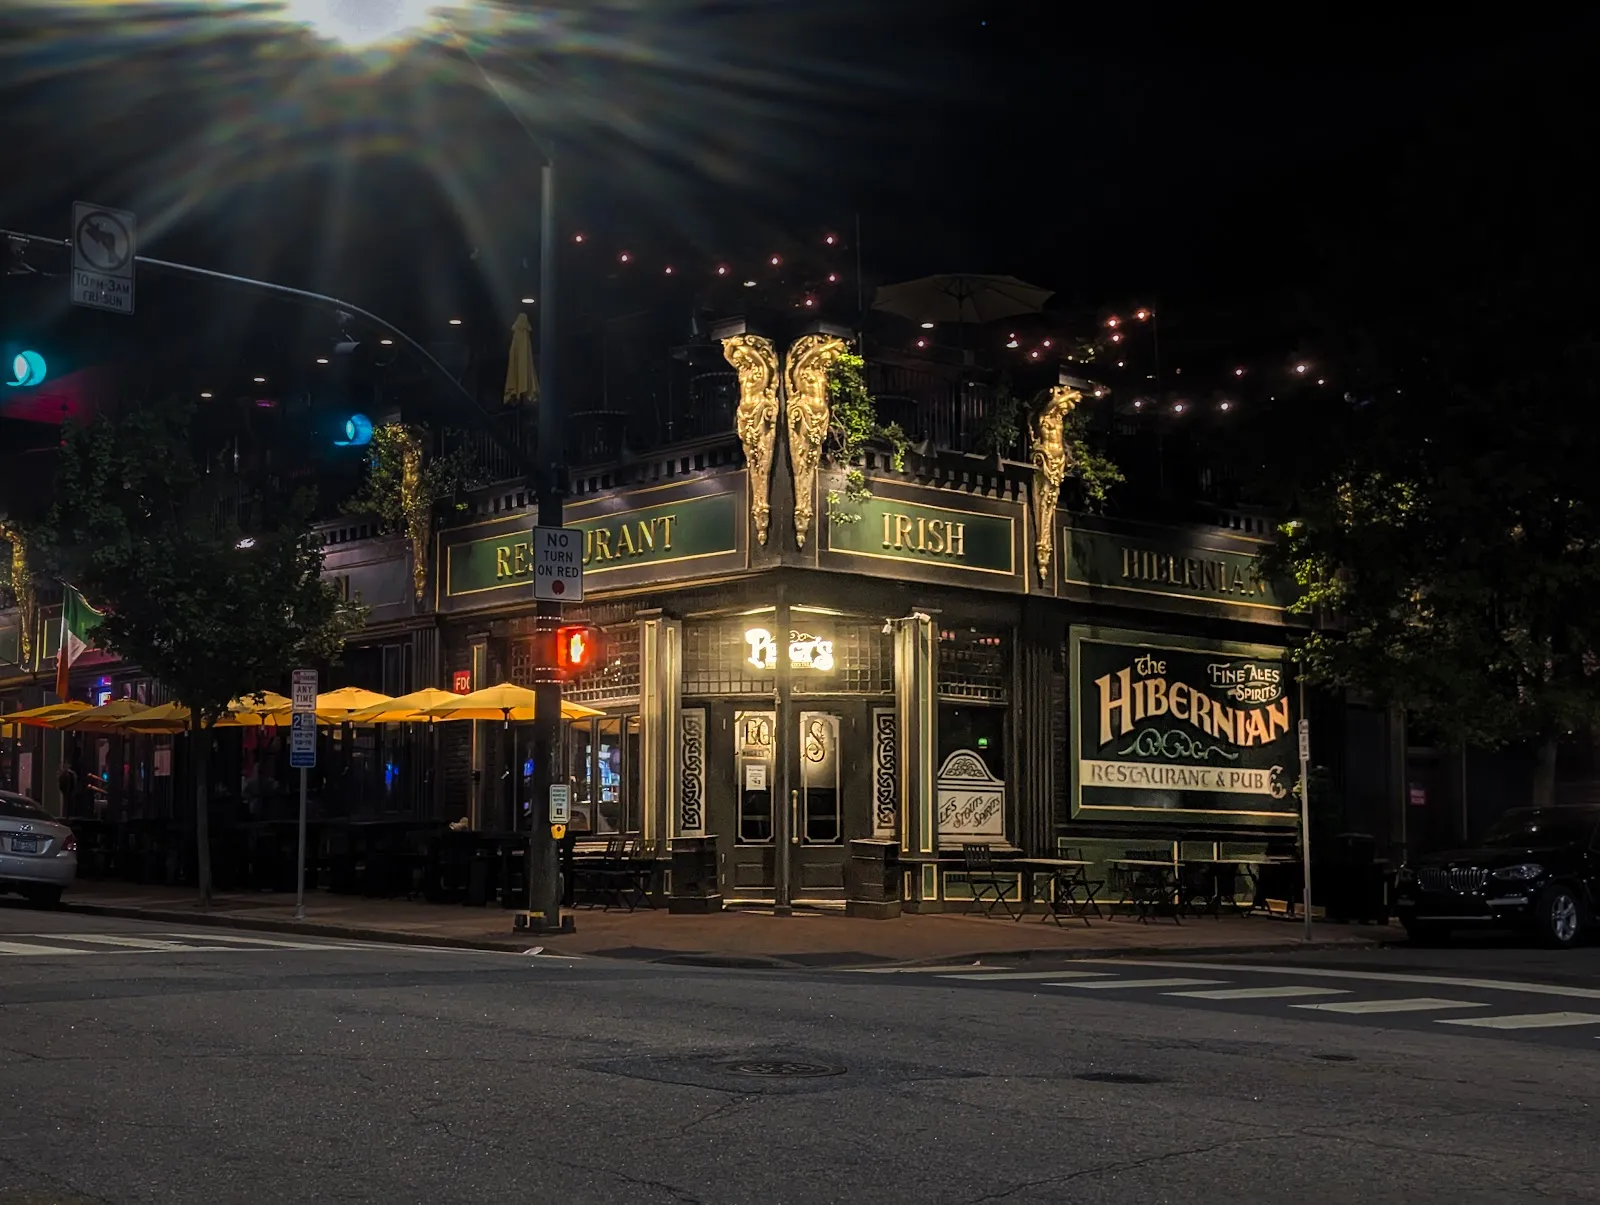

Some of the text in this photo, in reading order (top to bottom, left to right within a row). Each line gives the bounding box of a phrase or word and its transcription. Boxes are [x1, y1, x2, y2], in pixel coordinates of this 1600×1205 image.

[547, 533, 569, 548] NO
[882, 512, 966, 557] IRISH
[544, 550, 573, 562] TURN
[537, 564, 579, 578] ON RED
[1207, 663, 1280, 684] FINE ALES
[296, 685, 313, 694] ANY
[1236, 684, 1277, 702] SPIRITS
[295, 694, 313, 703] TIME
[1094, 667, 1290, 747] HIBERNIAN
[293, 714, 302, 729] 2
[1091, 764, 1264, 789] RESTAURANT & PUB
